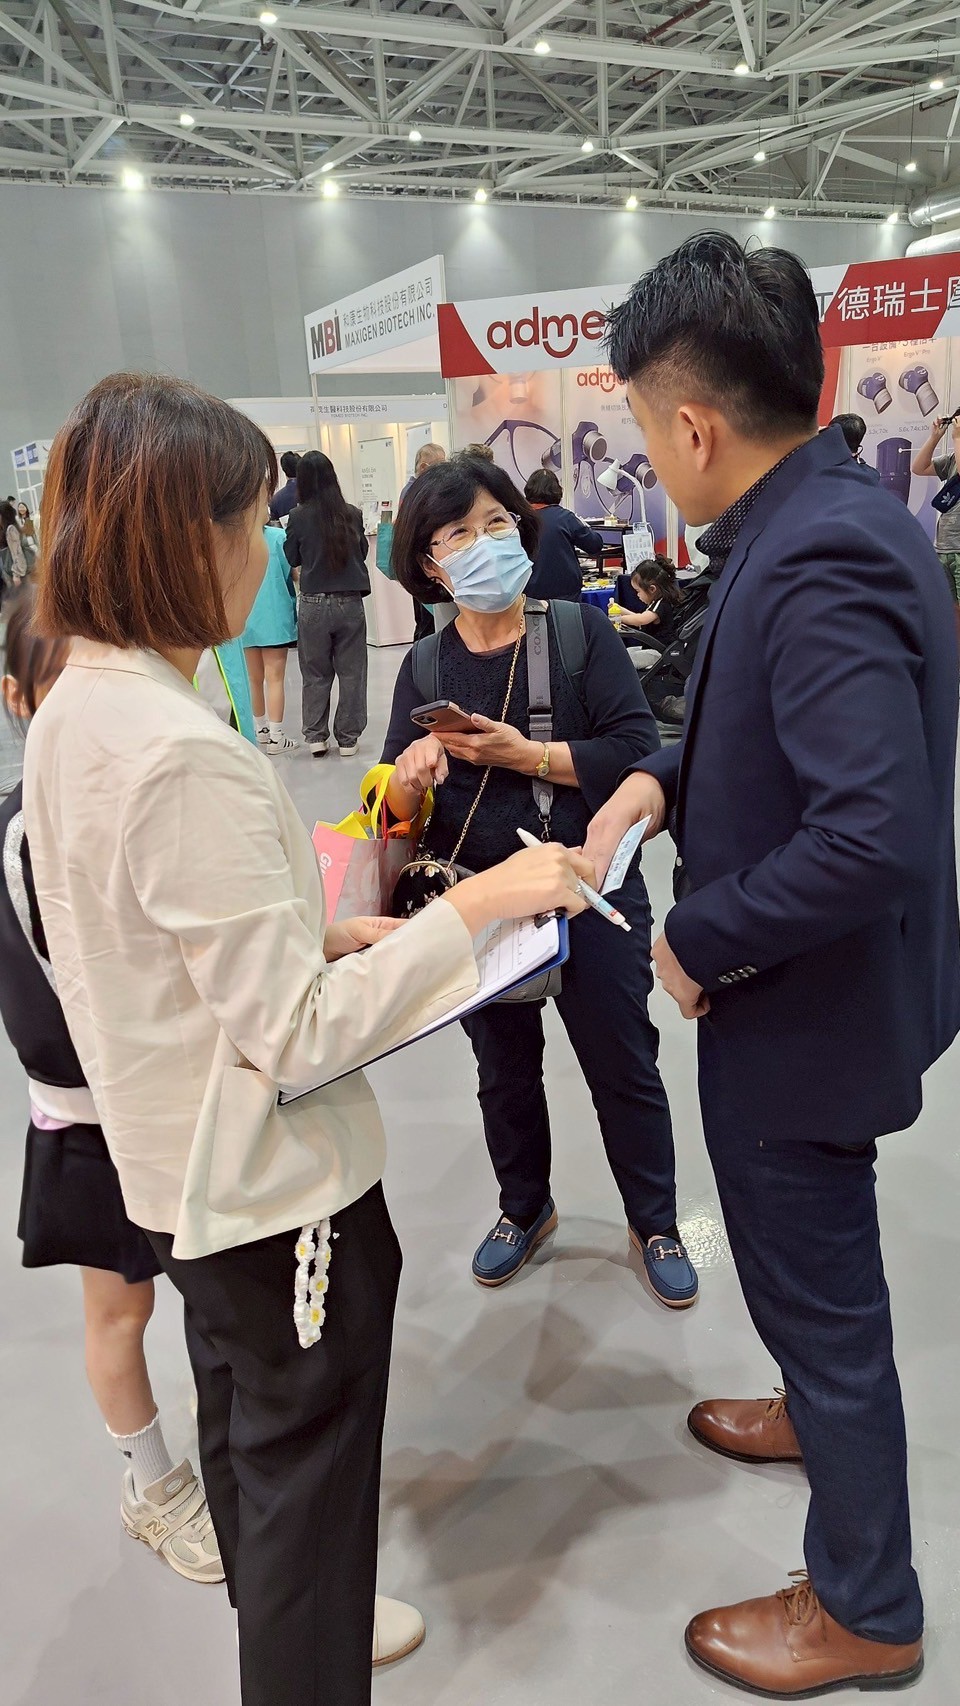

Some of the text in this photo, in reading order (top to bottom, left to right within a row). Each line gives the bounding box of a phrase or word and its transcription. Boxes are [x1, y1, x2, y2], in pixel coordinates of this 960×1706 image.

[342, 276, 433, 326] 和康生物科技股份有限公司
[344, 302, 435, 348] MAXIGEN BIOTECH INC.
